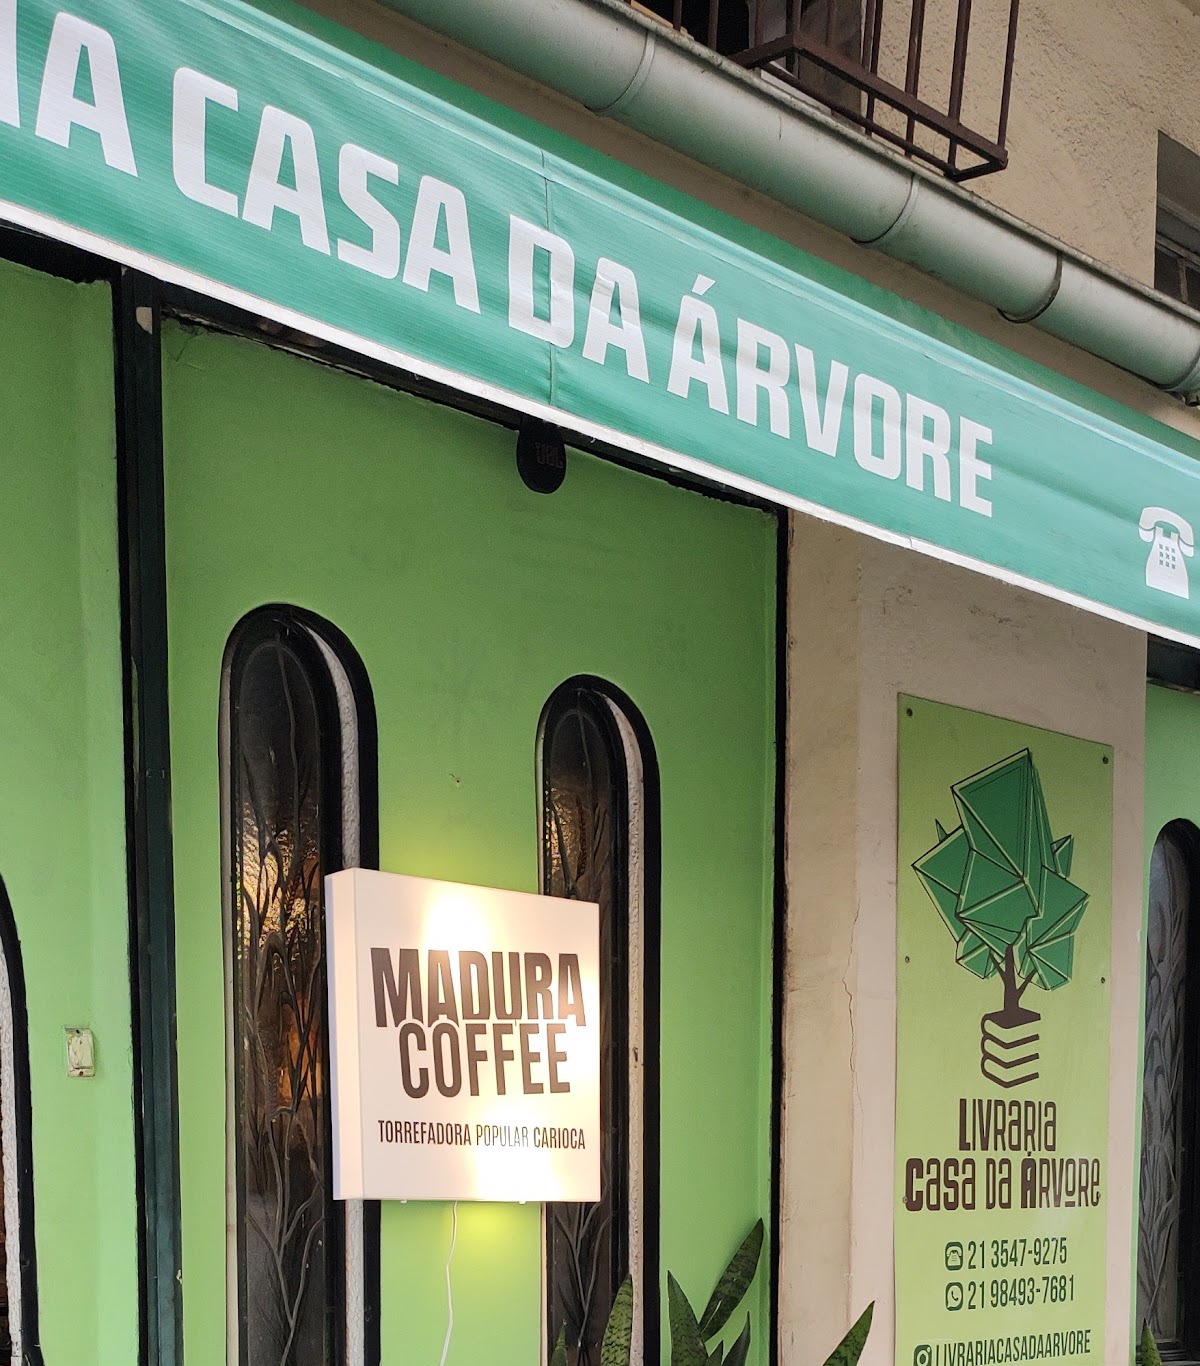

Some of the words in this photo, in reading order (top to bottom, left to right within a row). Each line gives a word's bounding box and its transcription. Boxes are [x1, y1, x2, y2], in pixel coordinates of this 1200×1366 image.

[172, 66, 482, 315] CASA
[508, 214, 650, 384] DA
[667, 275, 993, 518] ÁRVORE
[370, 947, 587, 1028] MADURA
[399, 1023, 571, 1099] COFFEE
[378, 1120, 472, 1147] TORREFADORA
[476, 1124, 530, 1148] POPULAR
[533, 1126, 586, 1150] CARIOCA
[967, 1240, 986, 1270] 21
[990, 1236, 1068, 1269] 3547-9275
[967, 1281, 986, 1310] 21
[990, 1273, 1075, 1309] 98493-7681
